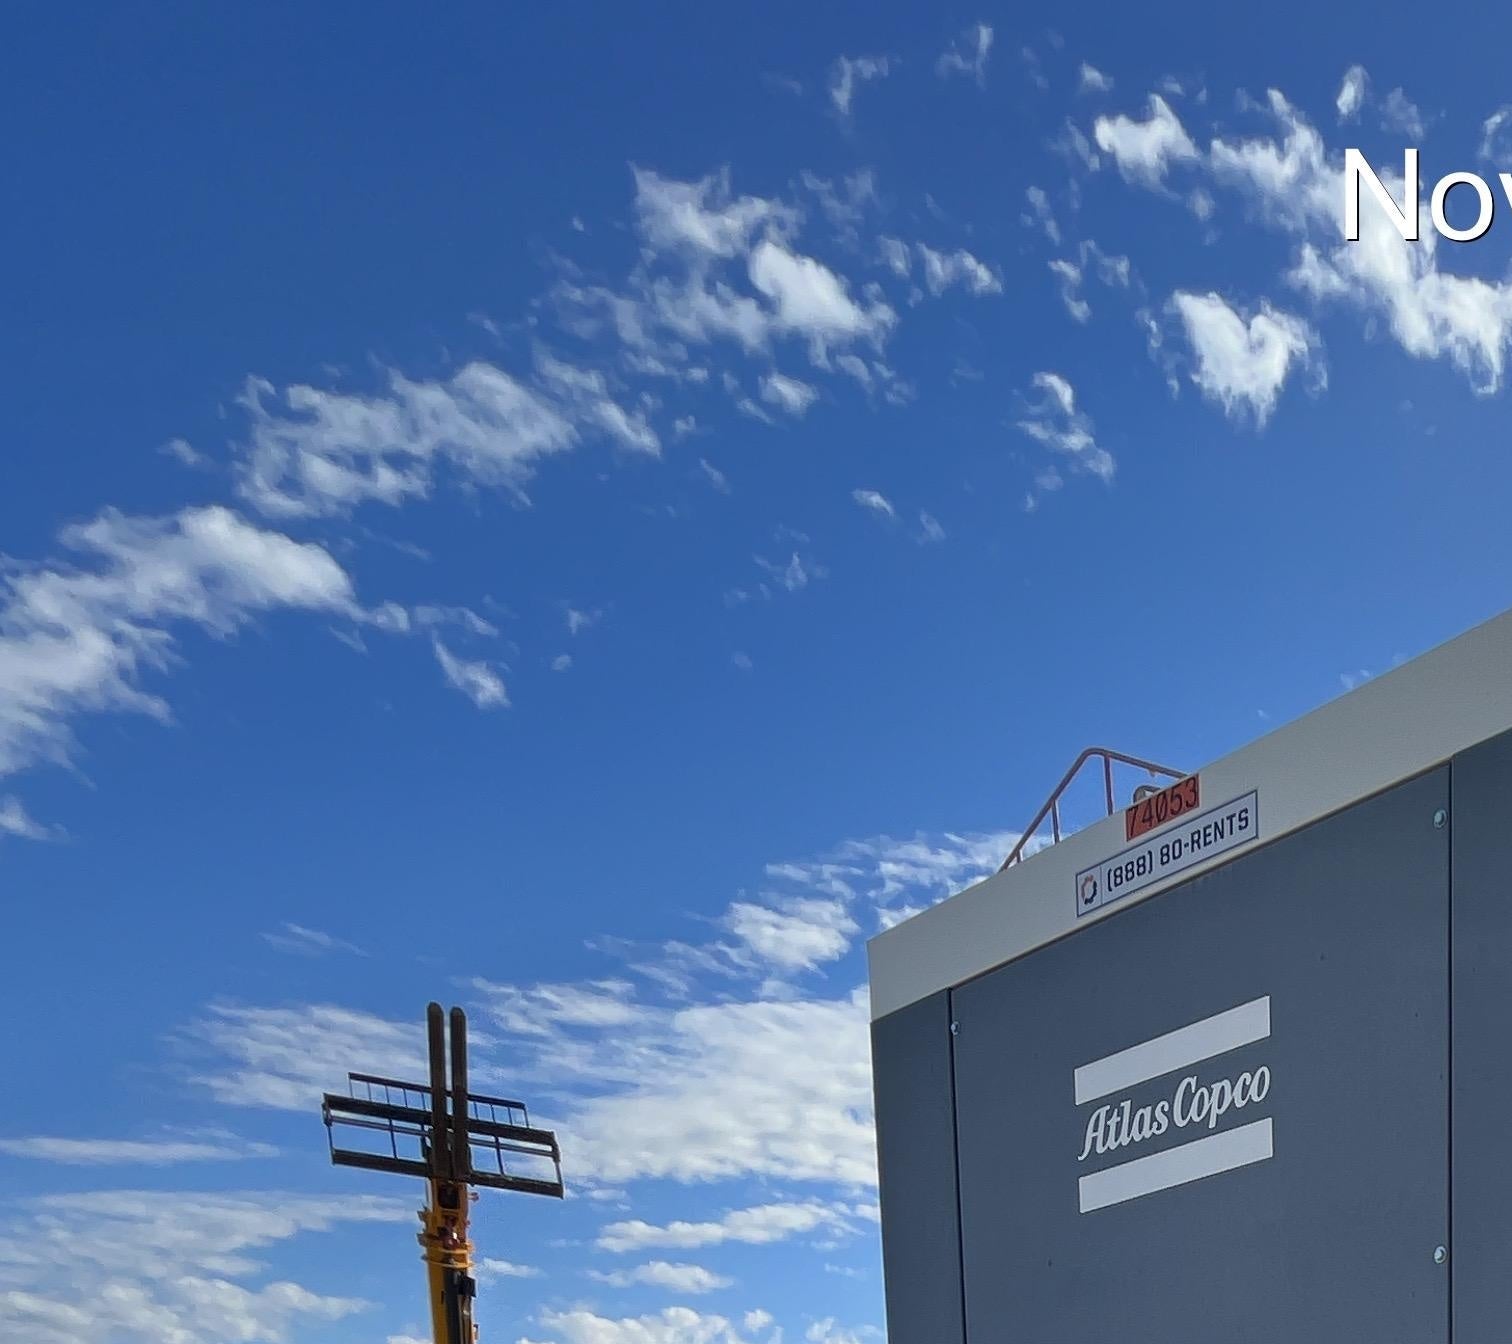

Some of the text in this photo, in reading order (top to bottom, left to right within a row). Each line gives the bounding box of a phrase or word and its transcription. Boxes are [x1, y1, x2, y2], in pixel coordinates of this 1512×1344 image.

[1127, 776, 1198, 837] 74053
[1107, 807, 1249, 892] (888) 80-RENTS
[1077, 1065, 1271, 1161] Atlas Copco
